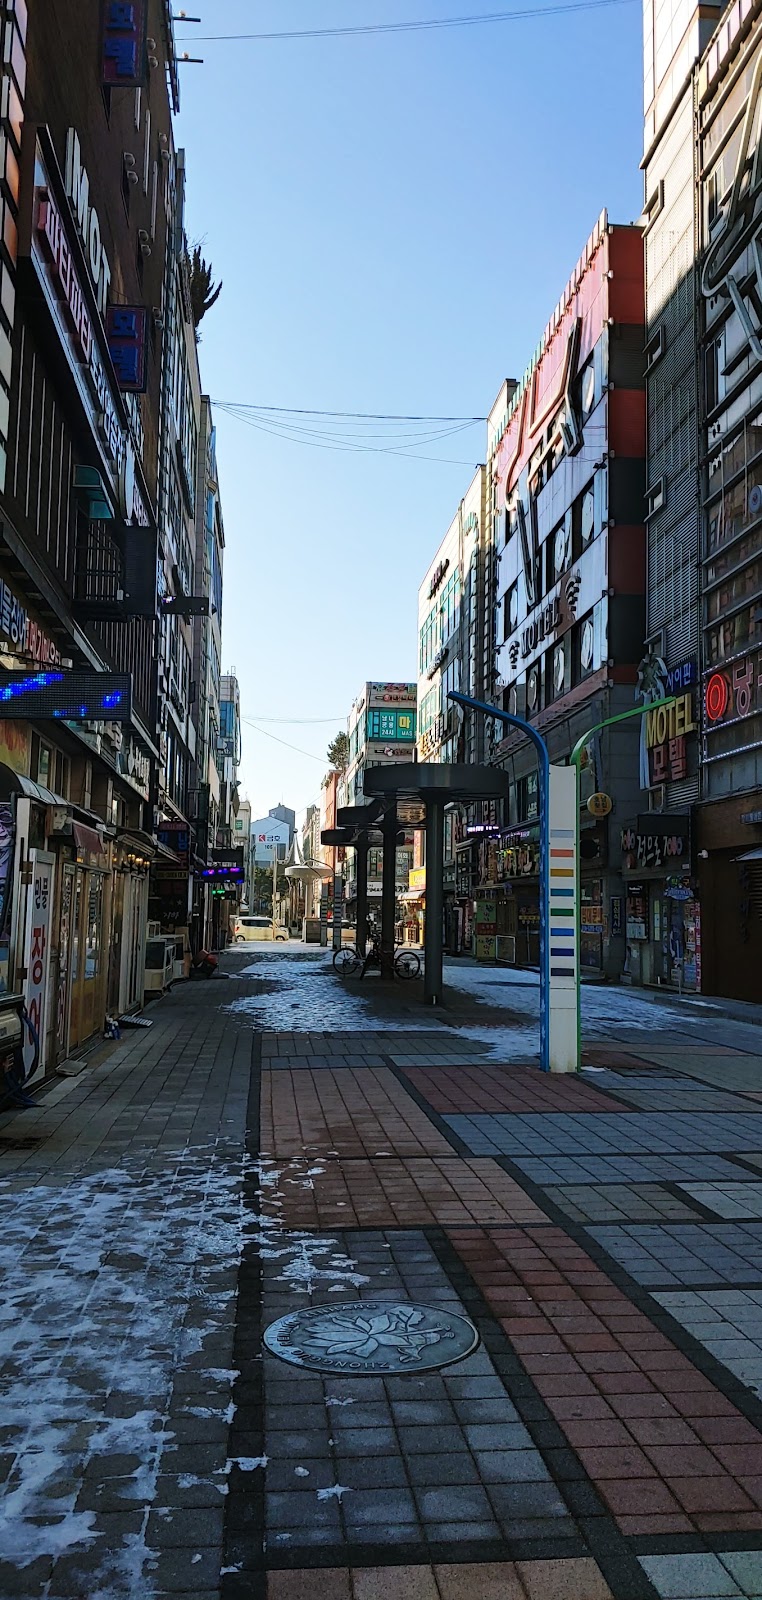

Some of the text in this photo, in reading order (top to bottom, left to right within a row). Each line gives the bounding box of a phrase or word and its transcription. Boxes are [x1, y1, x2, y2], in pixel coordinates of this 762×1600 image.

[109, 311, 138, 384] 모텔
[0, 577, 28, 652] 물장어
[520, 597, 562, 658] MOTEL
[666, 662, 691, 692] 사이판
[646, 693, 698, 749] MOTEL
[652, 736, 687, 782] 모텔
[35, 877, 48, 909] 민물
[29, 925, 45, 1047] 장어
[291, 1349, 390, 1369] ZHONGGUO
